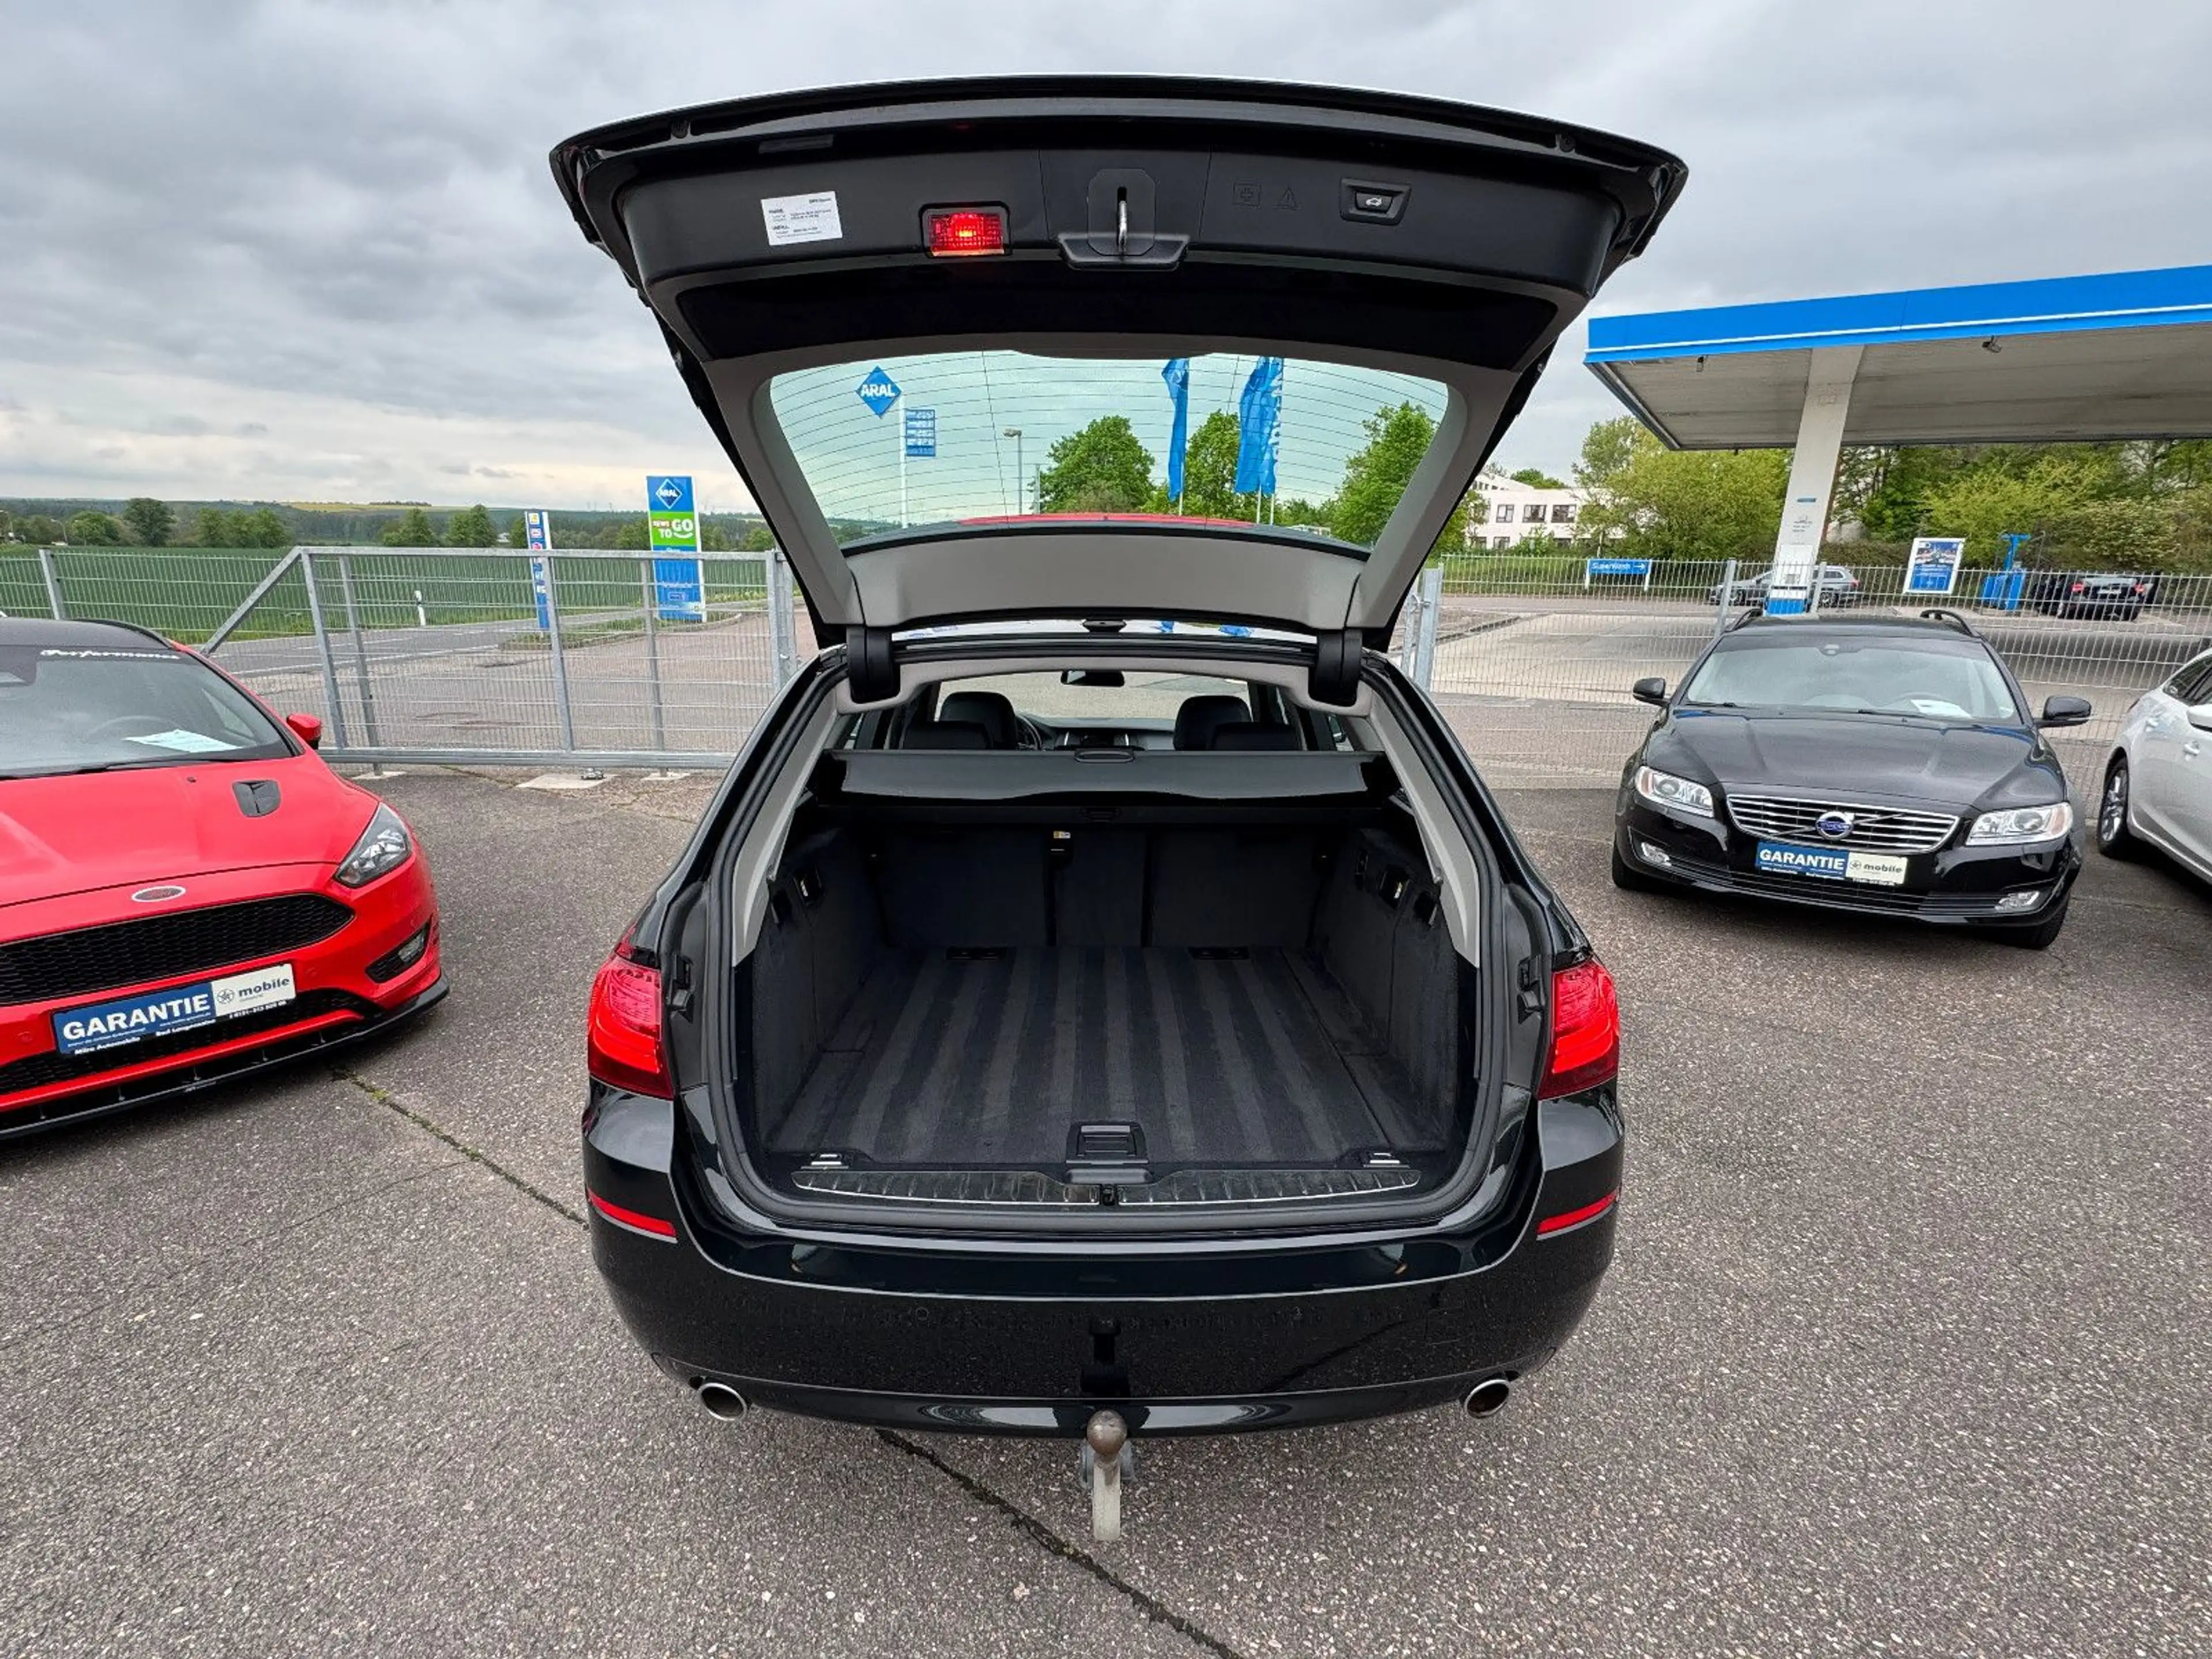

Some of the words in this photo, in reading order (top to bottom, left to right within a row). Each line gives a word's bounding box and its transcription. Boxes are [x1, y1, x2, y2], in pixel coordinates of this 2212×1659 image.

[861, 384, 895, 397] ARAL
[671, 518, 694, 532] GO
[659, 529, 672, 539] TO
[1759, 848, 1845, 870] GARANTIE
[1863, 863, 1903, 873] mobile
[238, 978, 290, 997] mobile
[63, 993, 211, 1040] GARANTIE
